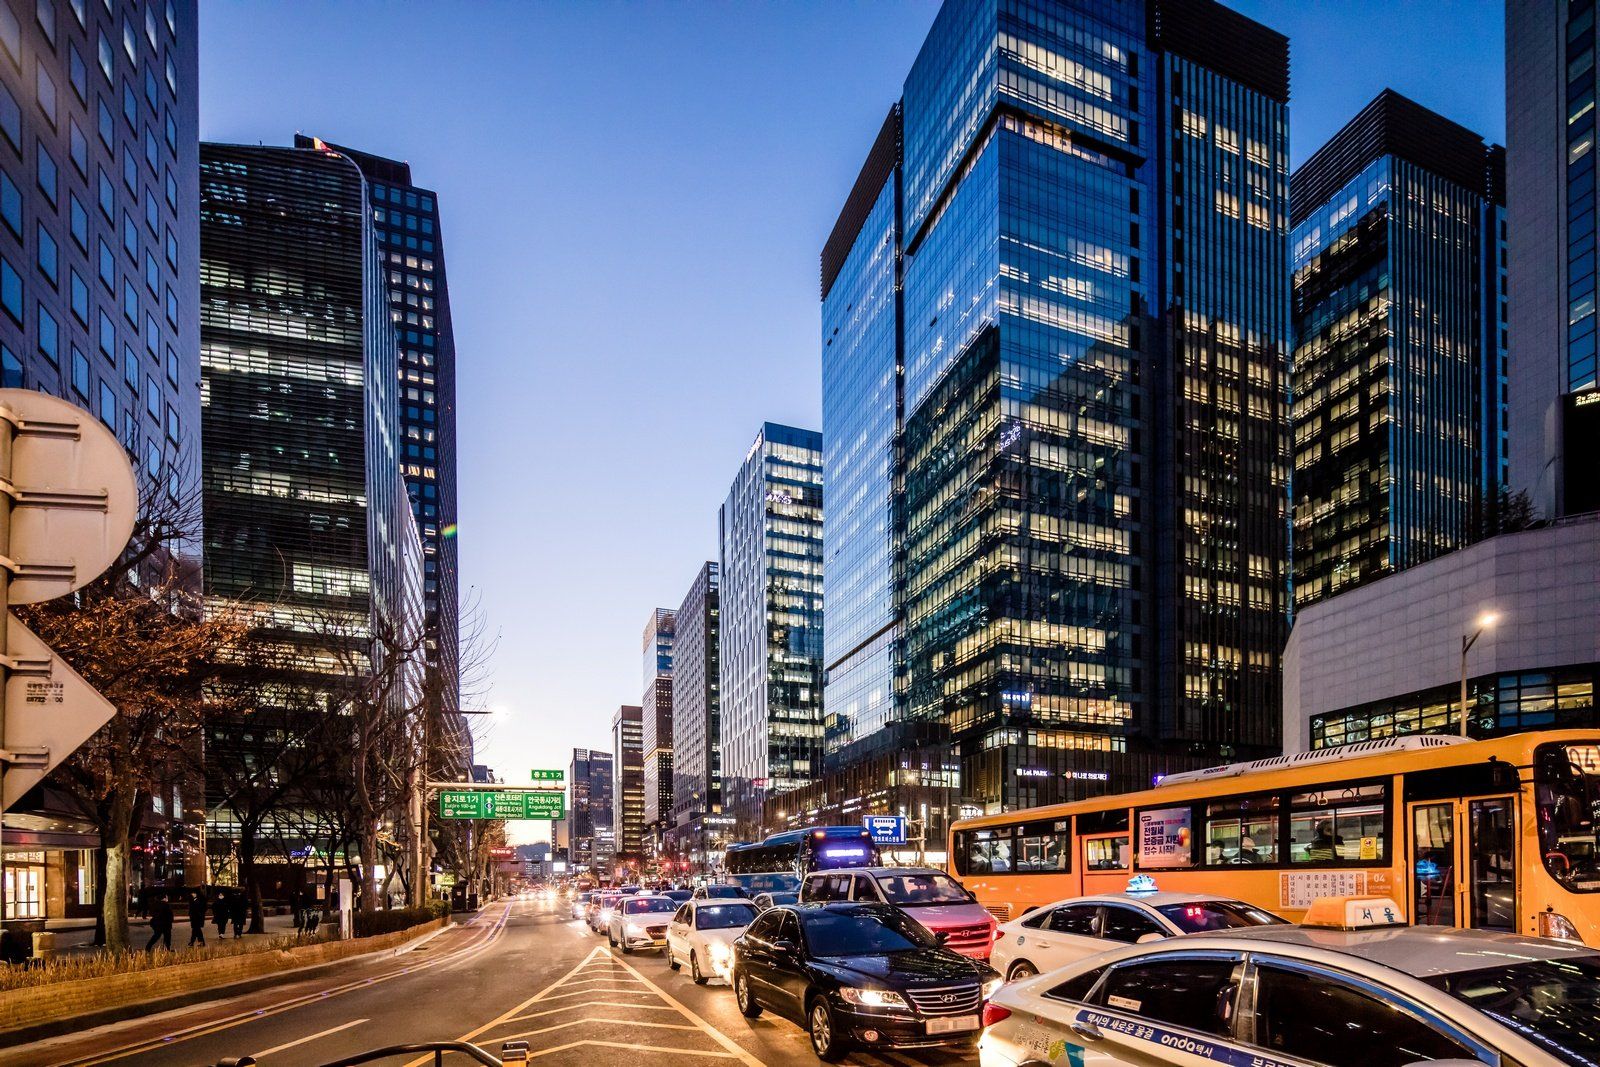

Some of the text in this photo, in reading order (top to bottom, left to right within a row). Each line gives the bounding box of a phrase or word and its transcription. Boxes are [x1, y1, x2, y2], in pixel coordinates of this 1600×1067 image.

[1569, 748, 1596, 771] 04
[444, 794, 479, 803] 을지로1가
[528, 796, 561, 804] 안국동사거리
[1144, 826, 1164, 836] 전월세
[1144, 836, 1164, 845] 보증금
[1144, 845, 1175, 855] 접수 시작!
[1373, 873, 1385, 882] 04
[1363, 907, 1394, 923] 서울
[1087, 1013, 1108, 1027] 택시의
[1110, 1020, 1135, 1036] 새로운
[1135, 1026, 1154, 1040] 물결
